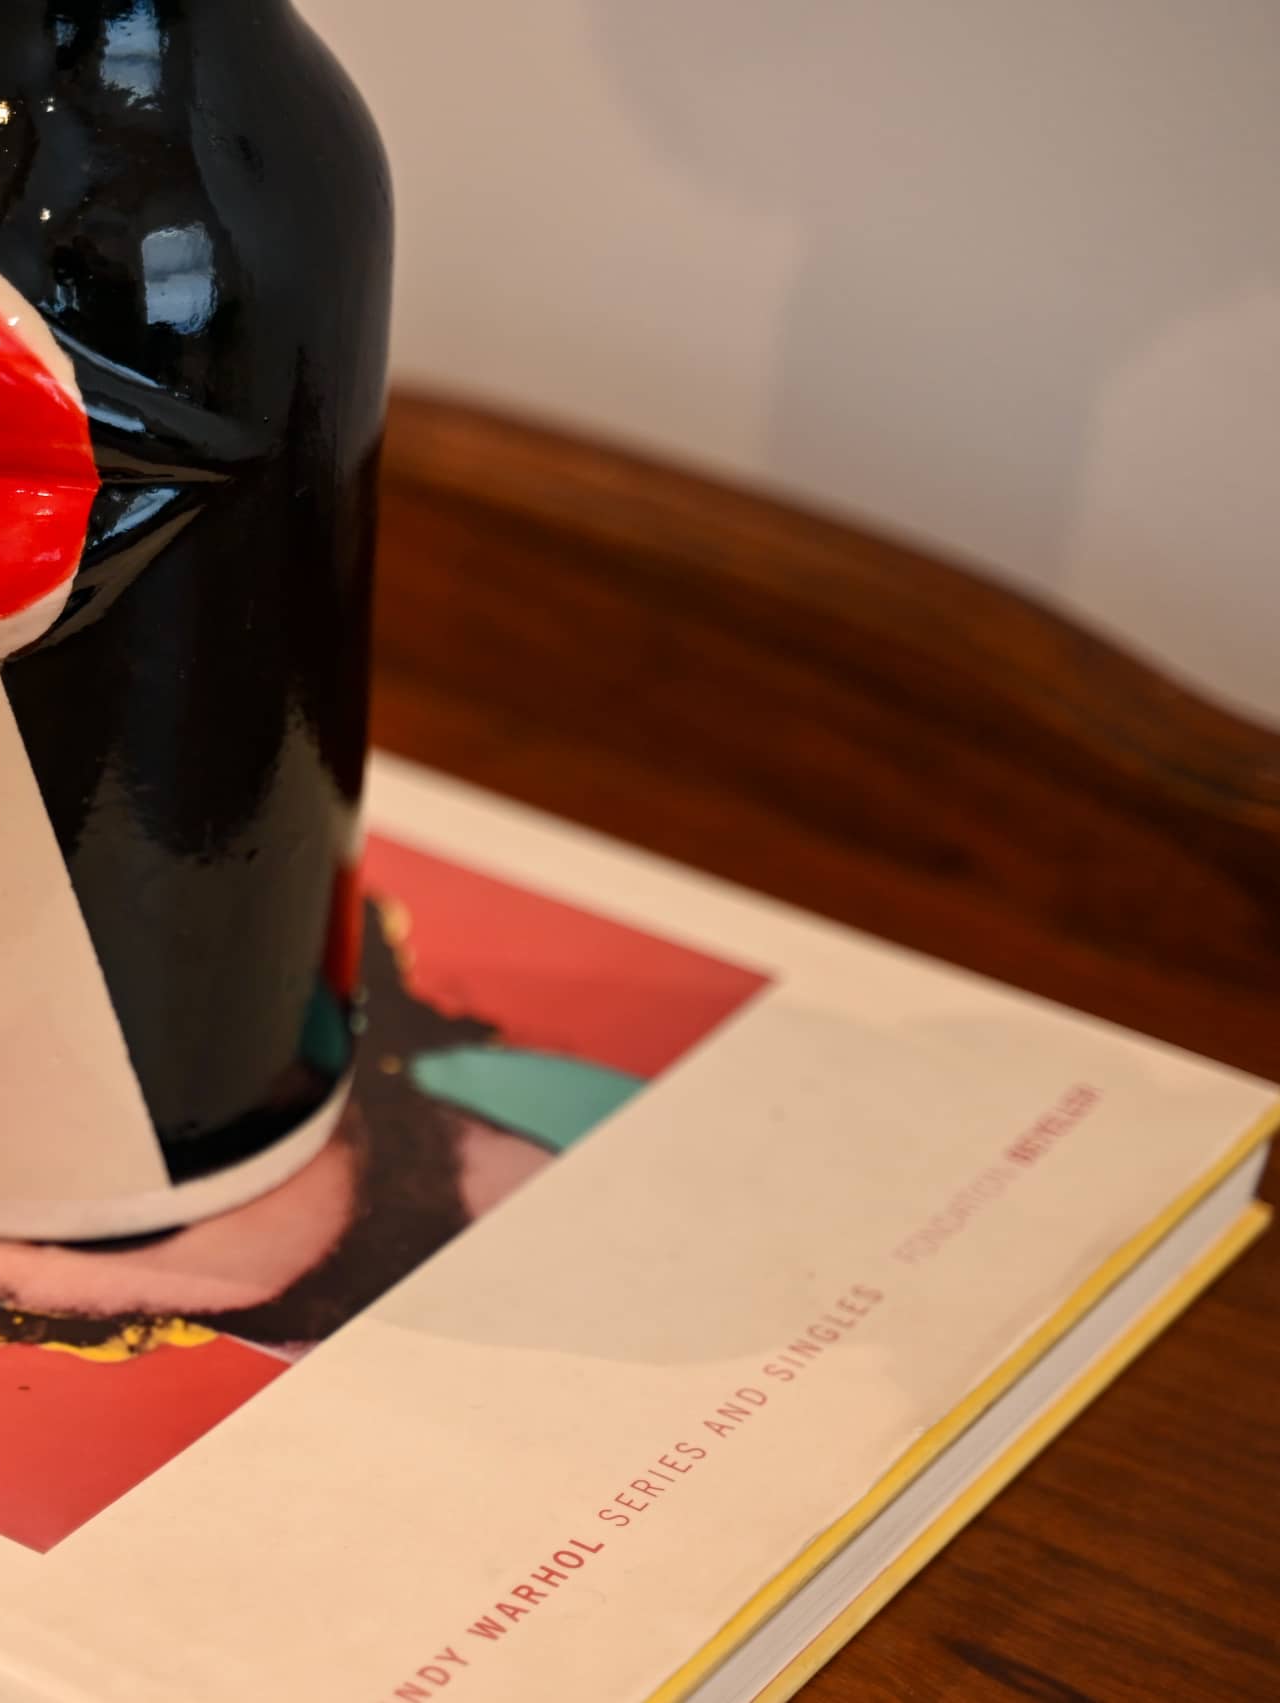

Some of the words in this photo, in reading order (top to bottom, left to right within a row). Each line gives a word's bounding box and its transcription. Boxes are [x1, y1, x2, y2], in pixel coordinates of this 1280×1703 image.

[376, 1646, 470, 1703] NDY
[466, 1538, 606, 1642] WARHOL
[597, 1441, 707, 1528] SERIES
[702, 1386, 769, 1439] AND
[761, 1283, 885, 1383] SINGLES
